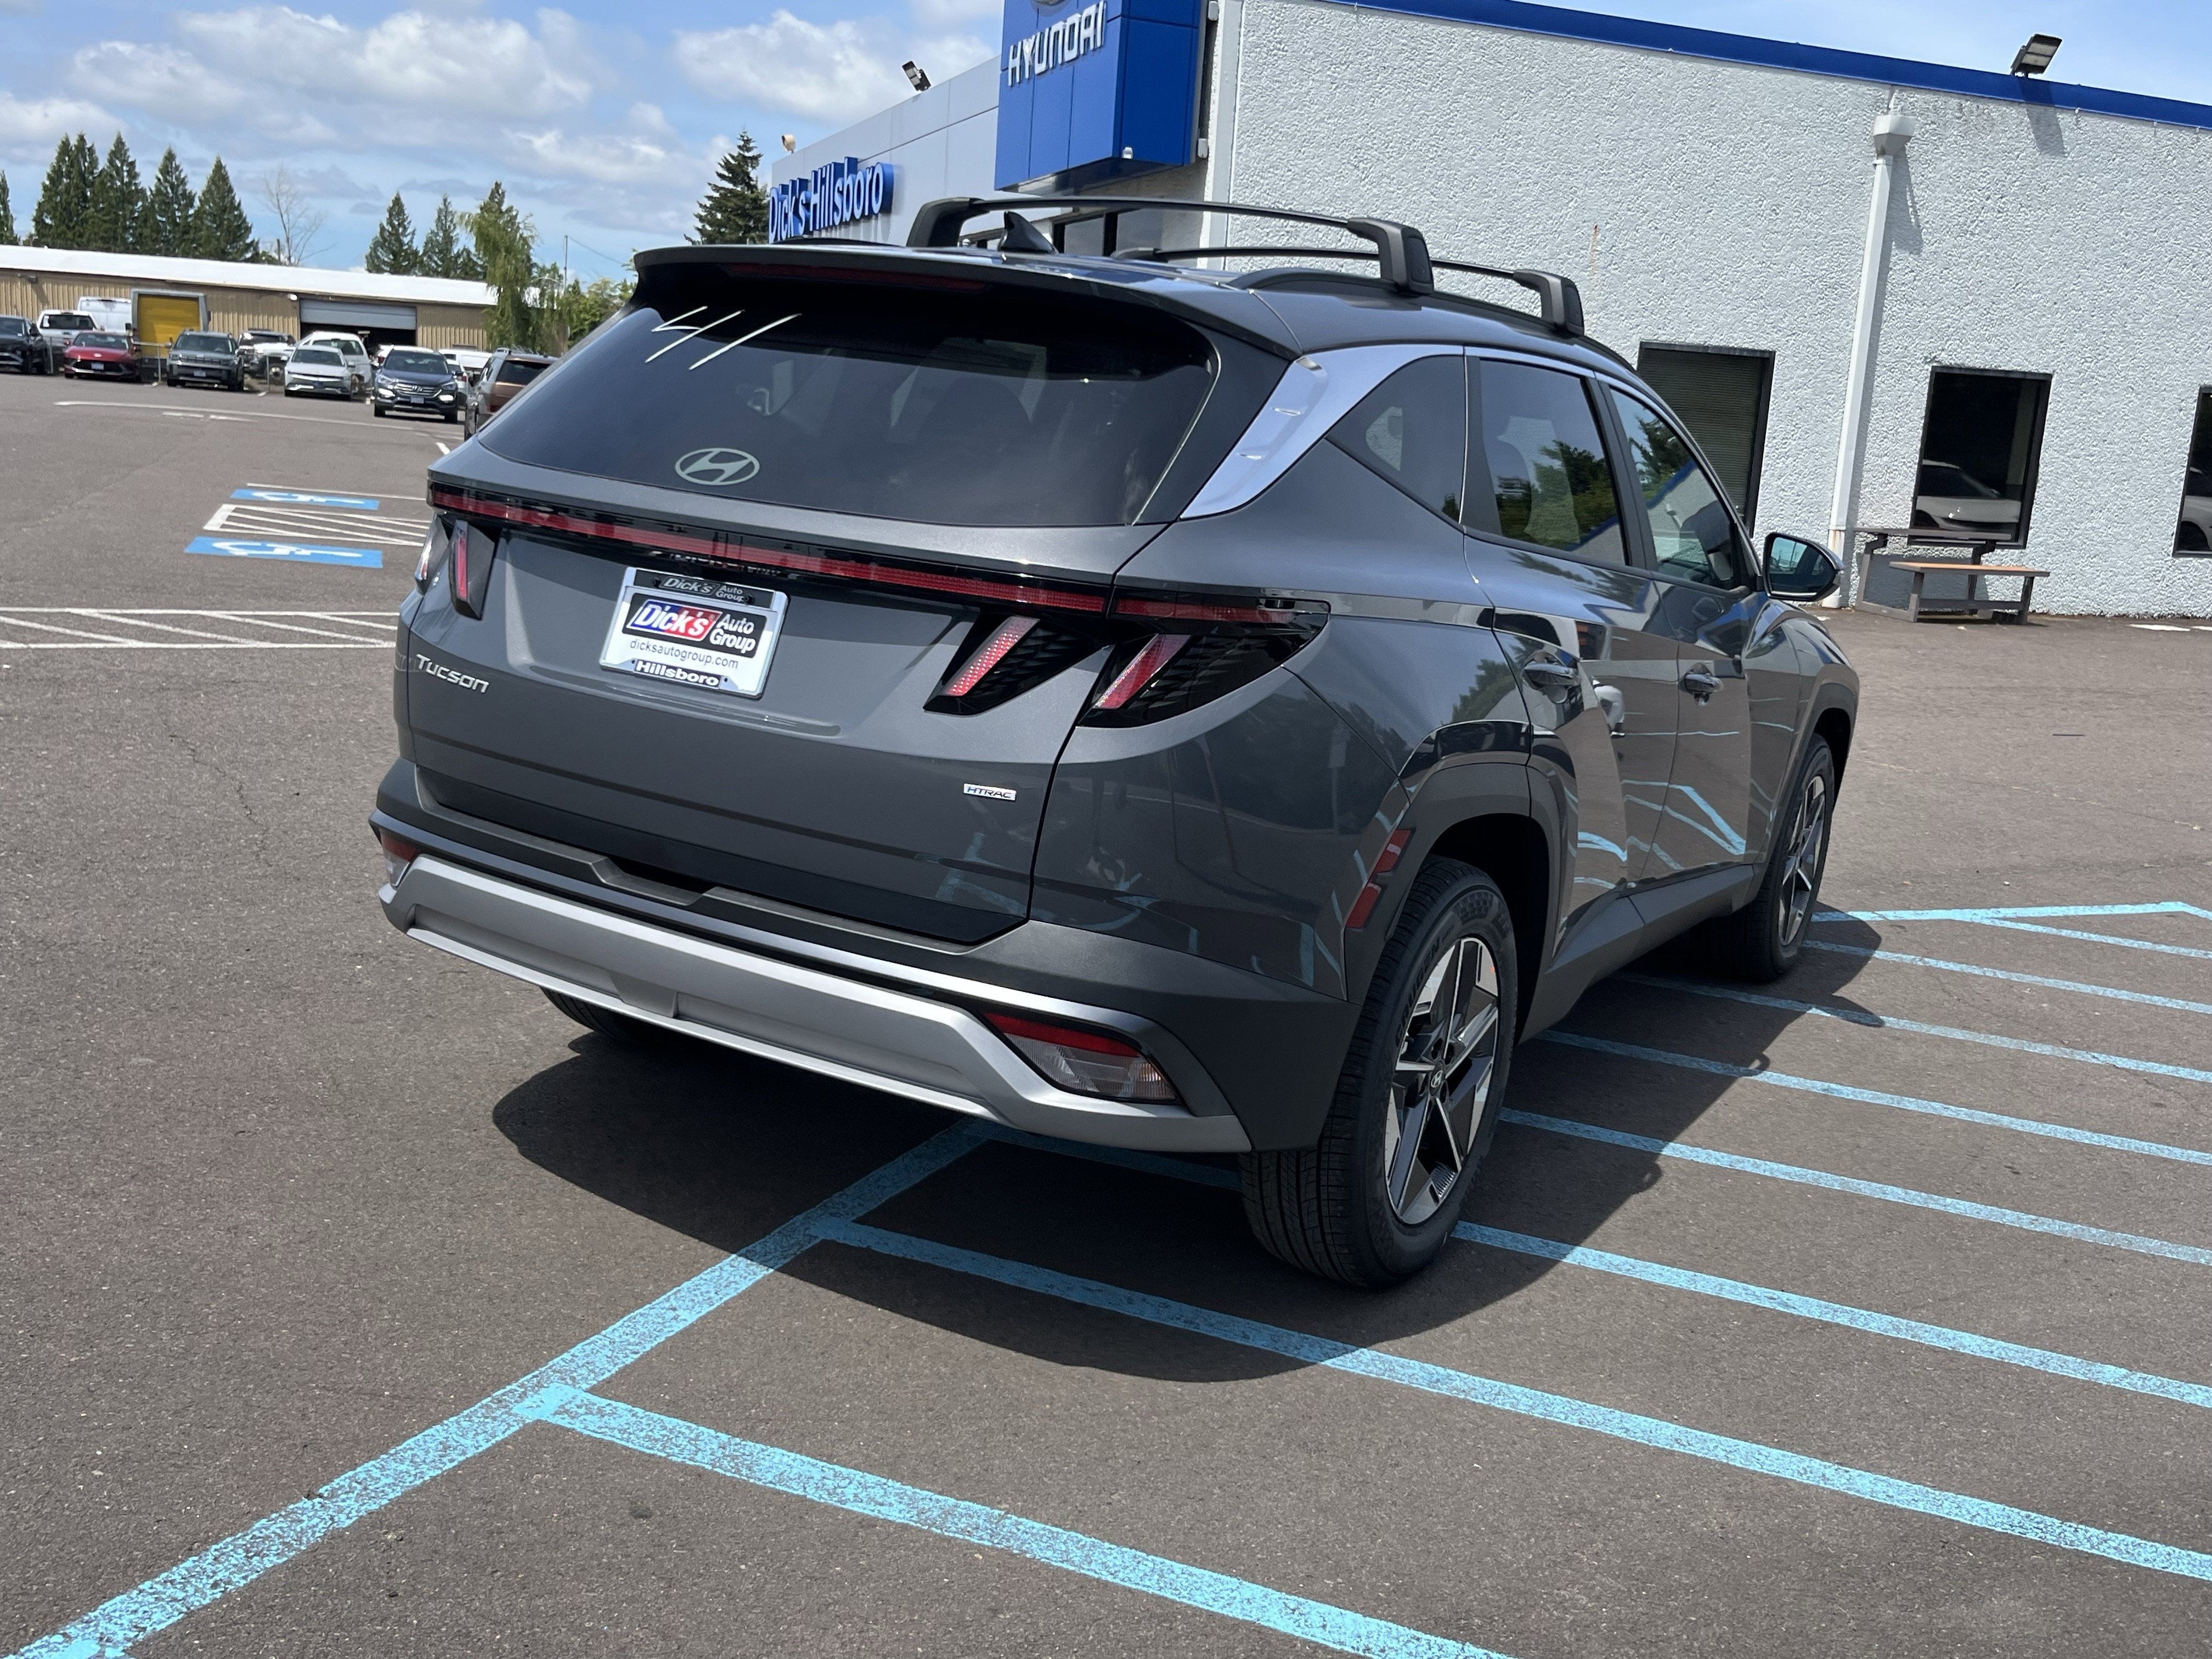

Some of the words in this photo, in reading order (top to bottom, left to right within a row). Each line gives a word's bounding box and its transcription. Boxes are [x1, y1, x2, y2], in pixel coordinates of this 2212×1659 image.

[1008, 1, 1106, 87] HYUNDAI
[769, 177, 808, 244] Dick's
[810, 156, 890, 232] Hillsboro
[664, 577, 713, 594] Dick's
[715, 590, 746, 603] Group
[720, 585, 743, 595] Auto
[634, 603, 709, 636] Dick's
[716, 613, 755, 635] Auto
[630, 639, 739, 669] dicksautogroup.com
[709, 628, 756, 654] Group
[416, 653, 489, 693] Tucson
[635, 660, 720, 686] Hillsboro
[967, 786, 1012, 799] HTRAC
